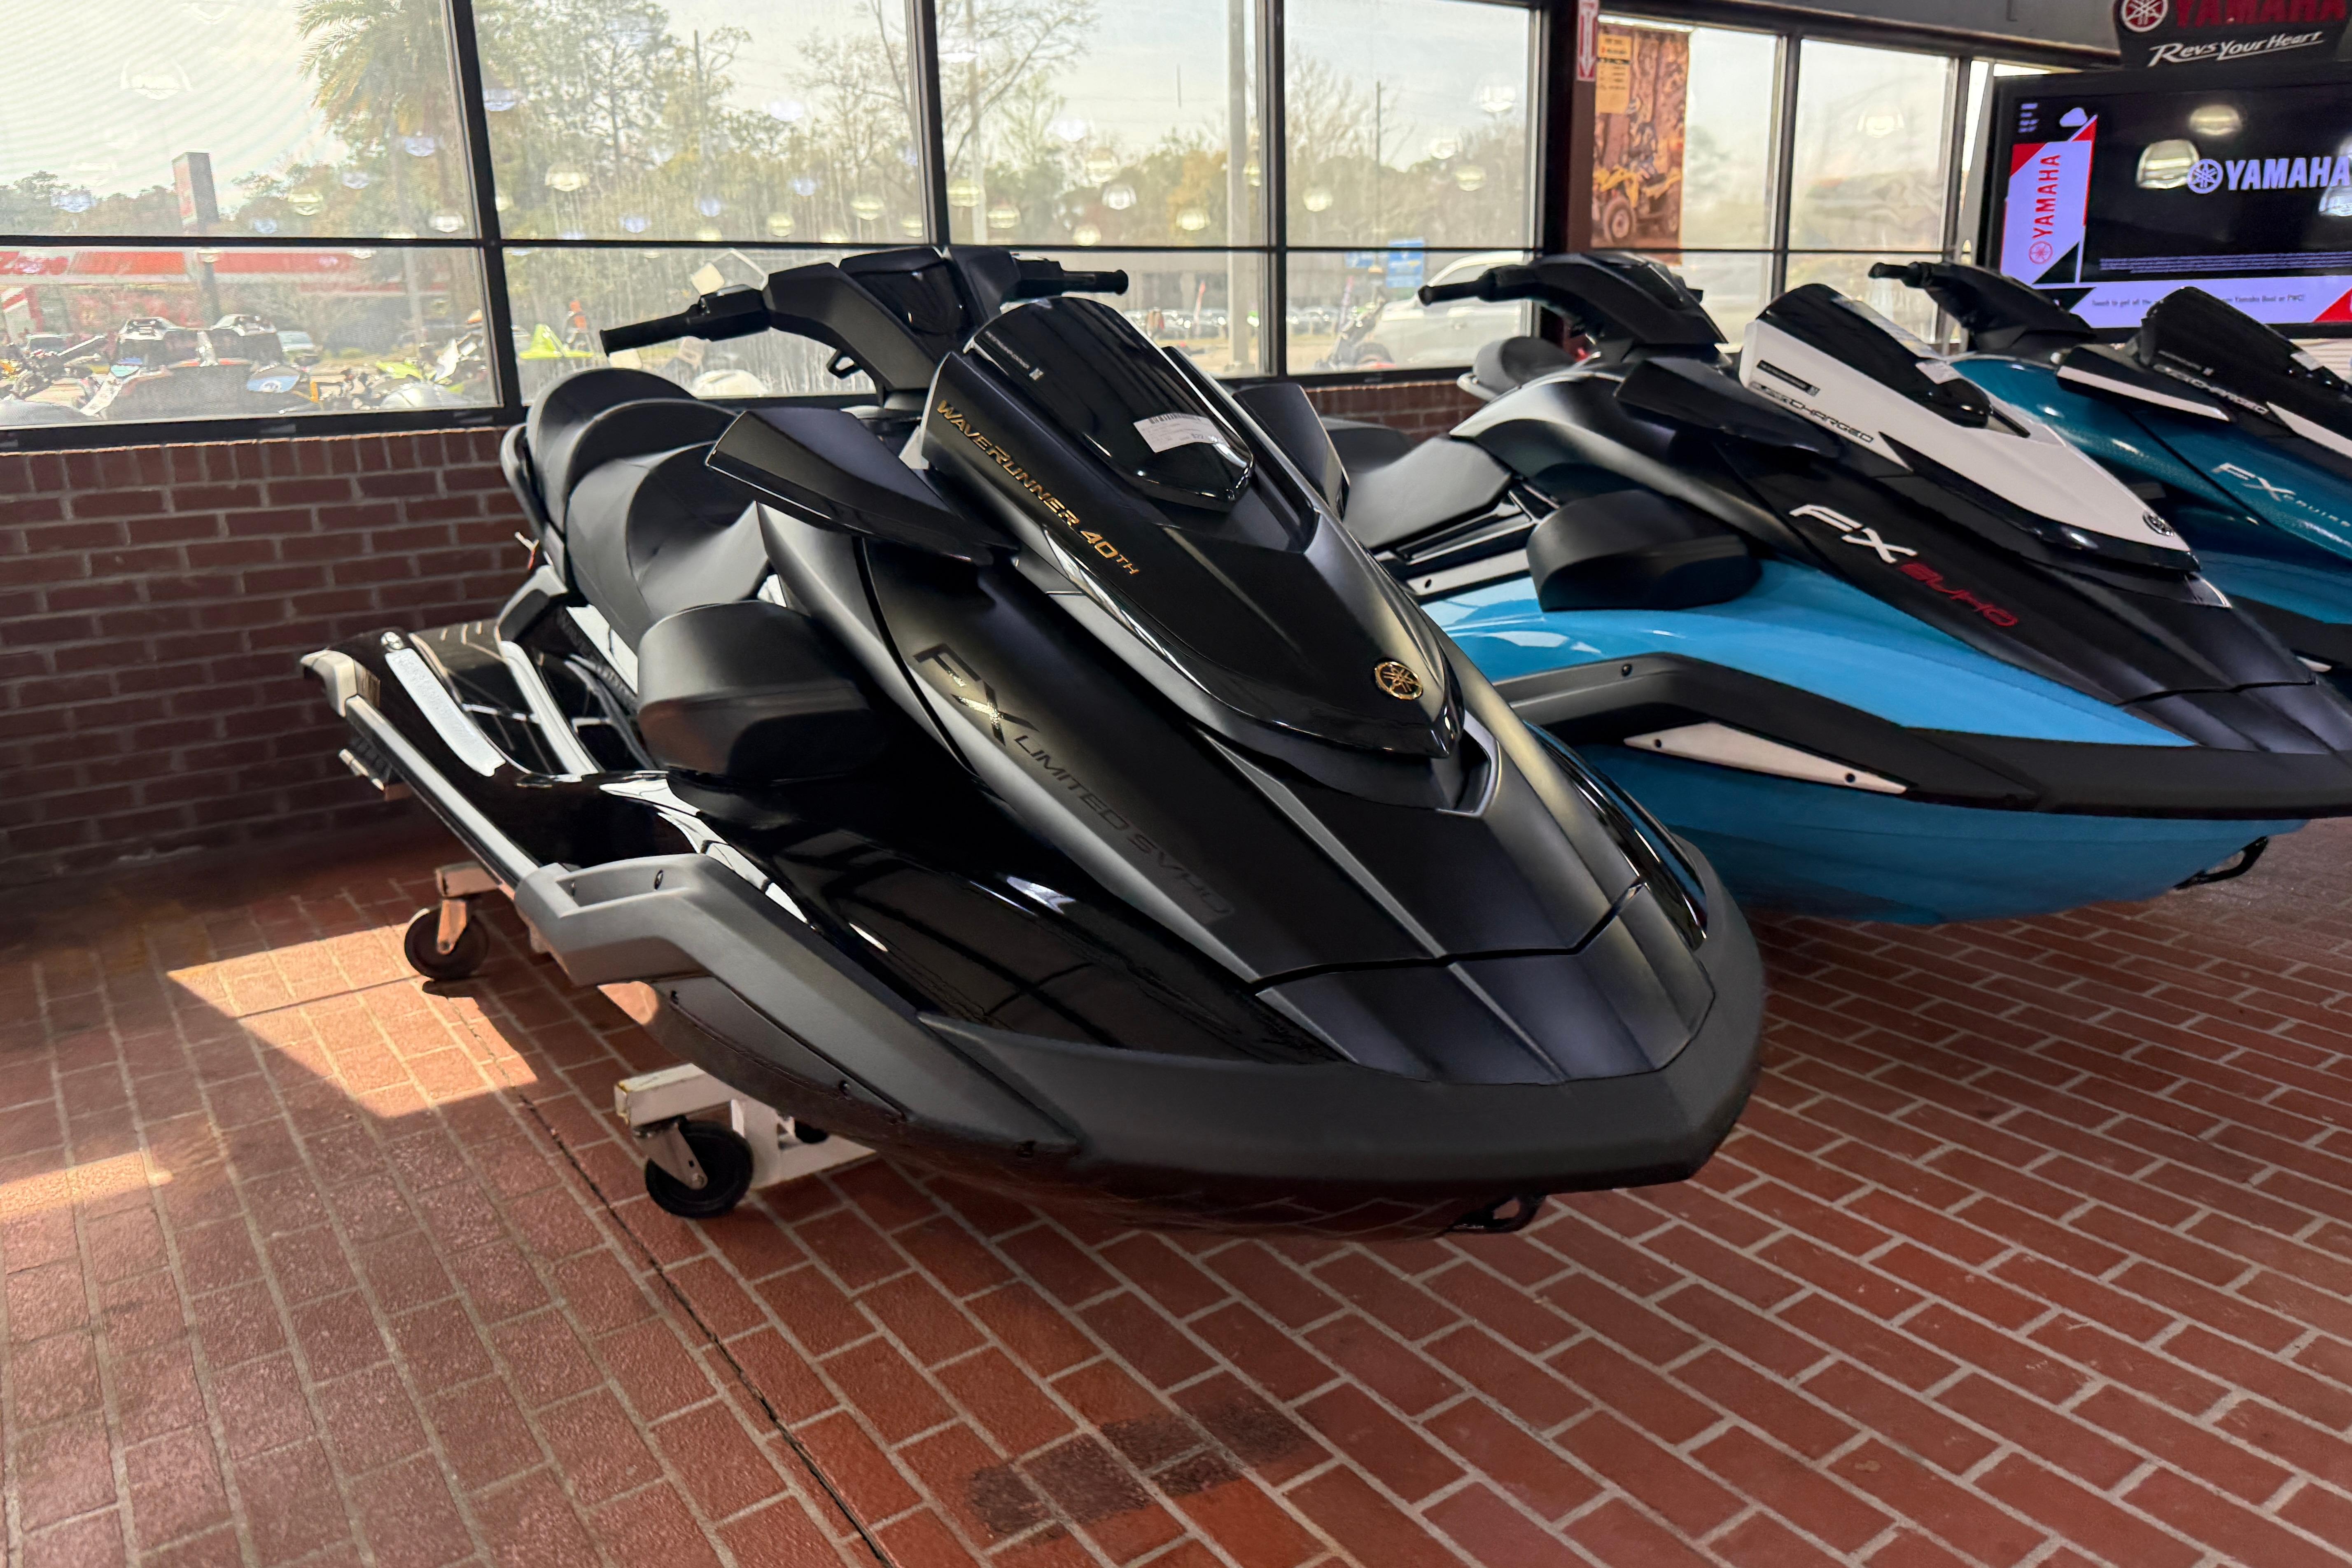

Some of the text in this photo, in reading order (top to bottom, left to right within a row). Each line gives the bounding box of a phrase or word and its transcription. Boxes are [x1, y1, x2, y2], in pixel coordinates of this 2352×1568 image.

[2147, 31, 2324, 67] Revs Your Heart
[2032, 155, 2061, 239] YAMAHA
[2225, 156, 2350, 191] YAMAHA
[937, 400, 1139, 575] WAVERUNNER 40TH
[2211, 462, 2296, 502] FX
[1789, 504, 1918, 563] FX
[912, 643, 1040, 746] FX
[1014, 735, 1130, 831] LIMITED
